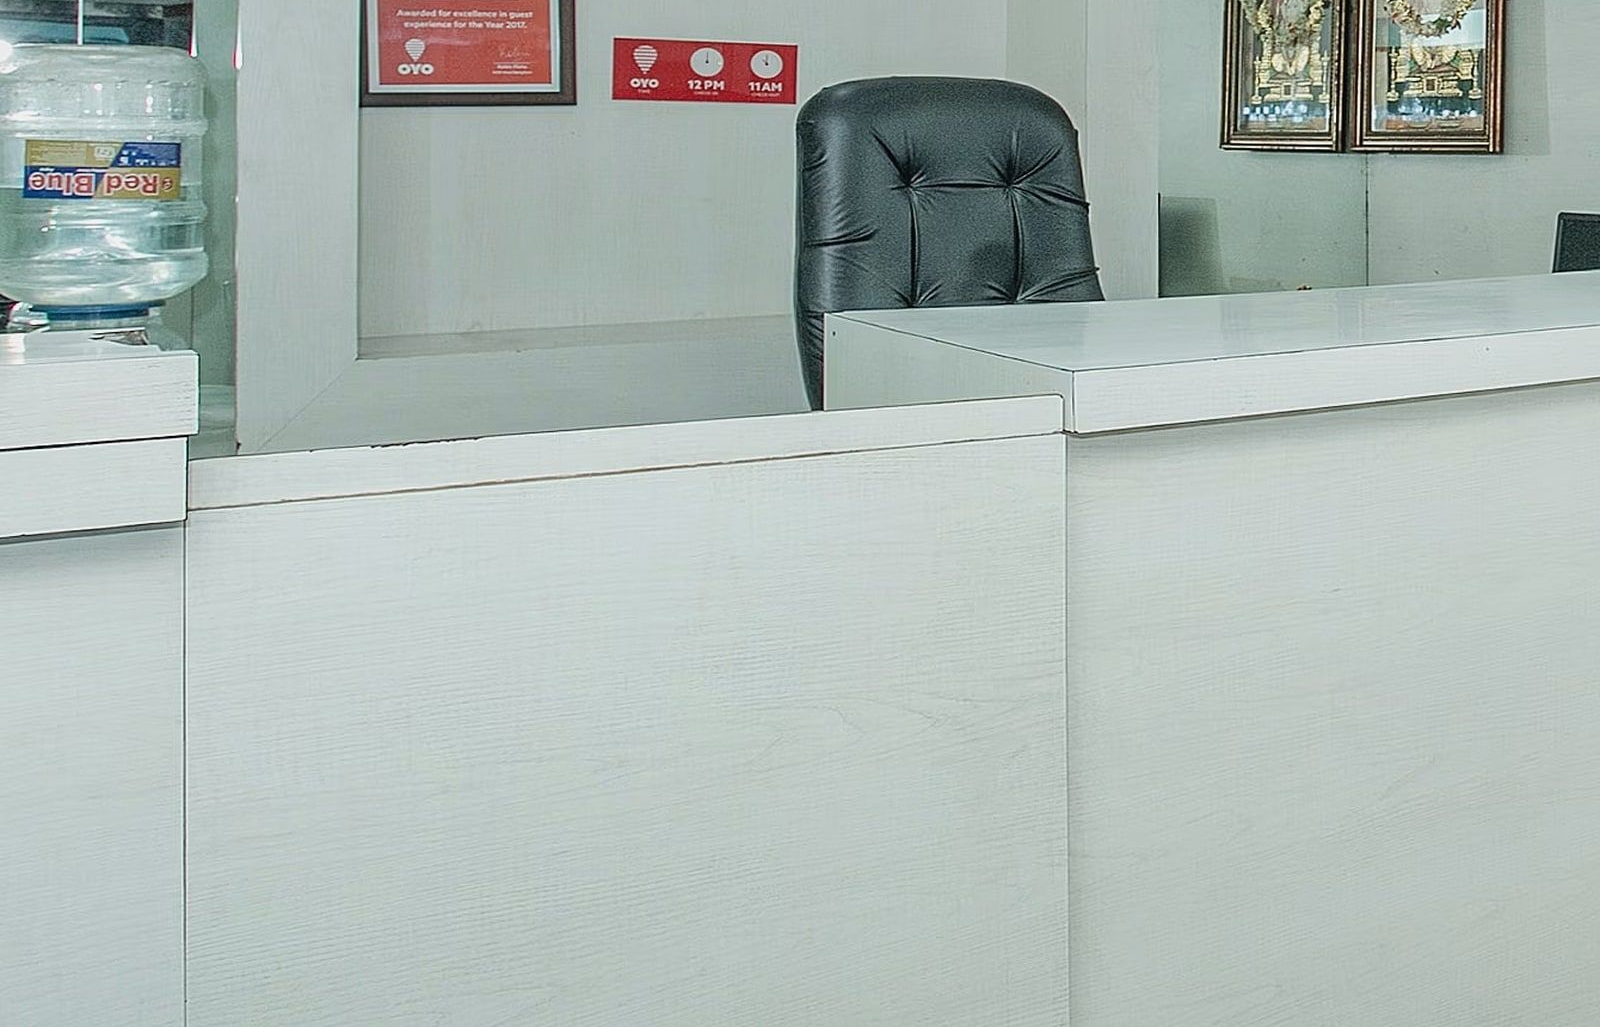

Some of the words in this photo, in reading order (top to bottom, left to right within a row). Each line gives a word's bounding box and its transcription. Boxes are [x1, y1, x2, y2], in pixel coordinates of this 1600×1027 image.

[396, 9, 437, 18] Awarded
[438, 9, 451, 18] for
[452, 9, 497, 18] excellence
[499, 10, 508, 18] in
[508, 11, 534, 20] guest
[404, 20, 451, 29] experience
[453, 20, 466, 29] for
[468, 20, 483, 29] the
[484, 20, 504, 29] Year
[397, 63, 435, 75] OYO
[629, 78, 660, 89] OYO
[688, 80, 702, 90] 12
[704, 80, 725, 91] PM
[28, 172, 97, 196] Blue
[103, 172, 160, 195] Red
